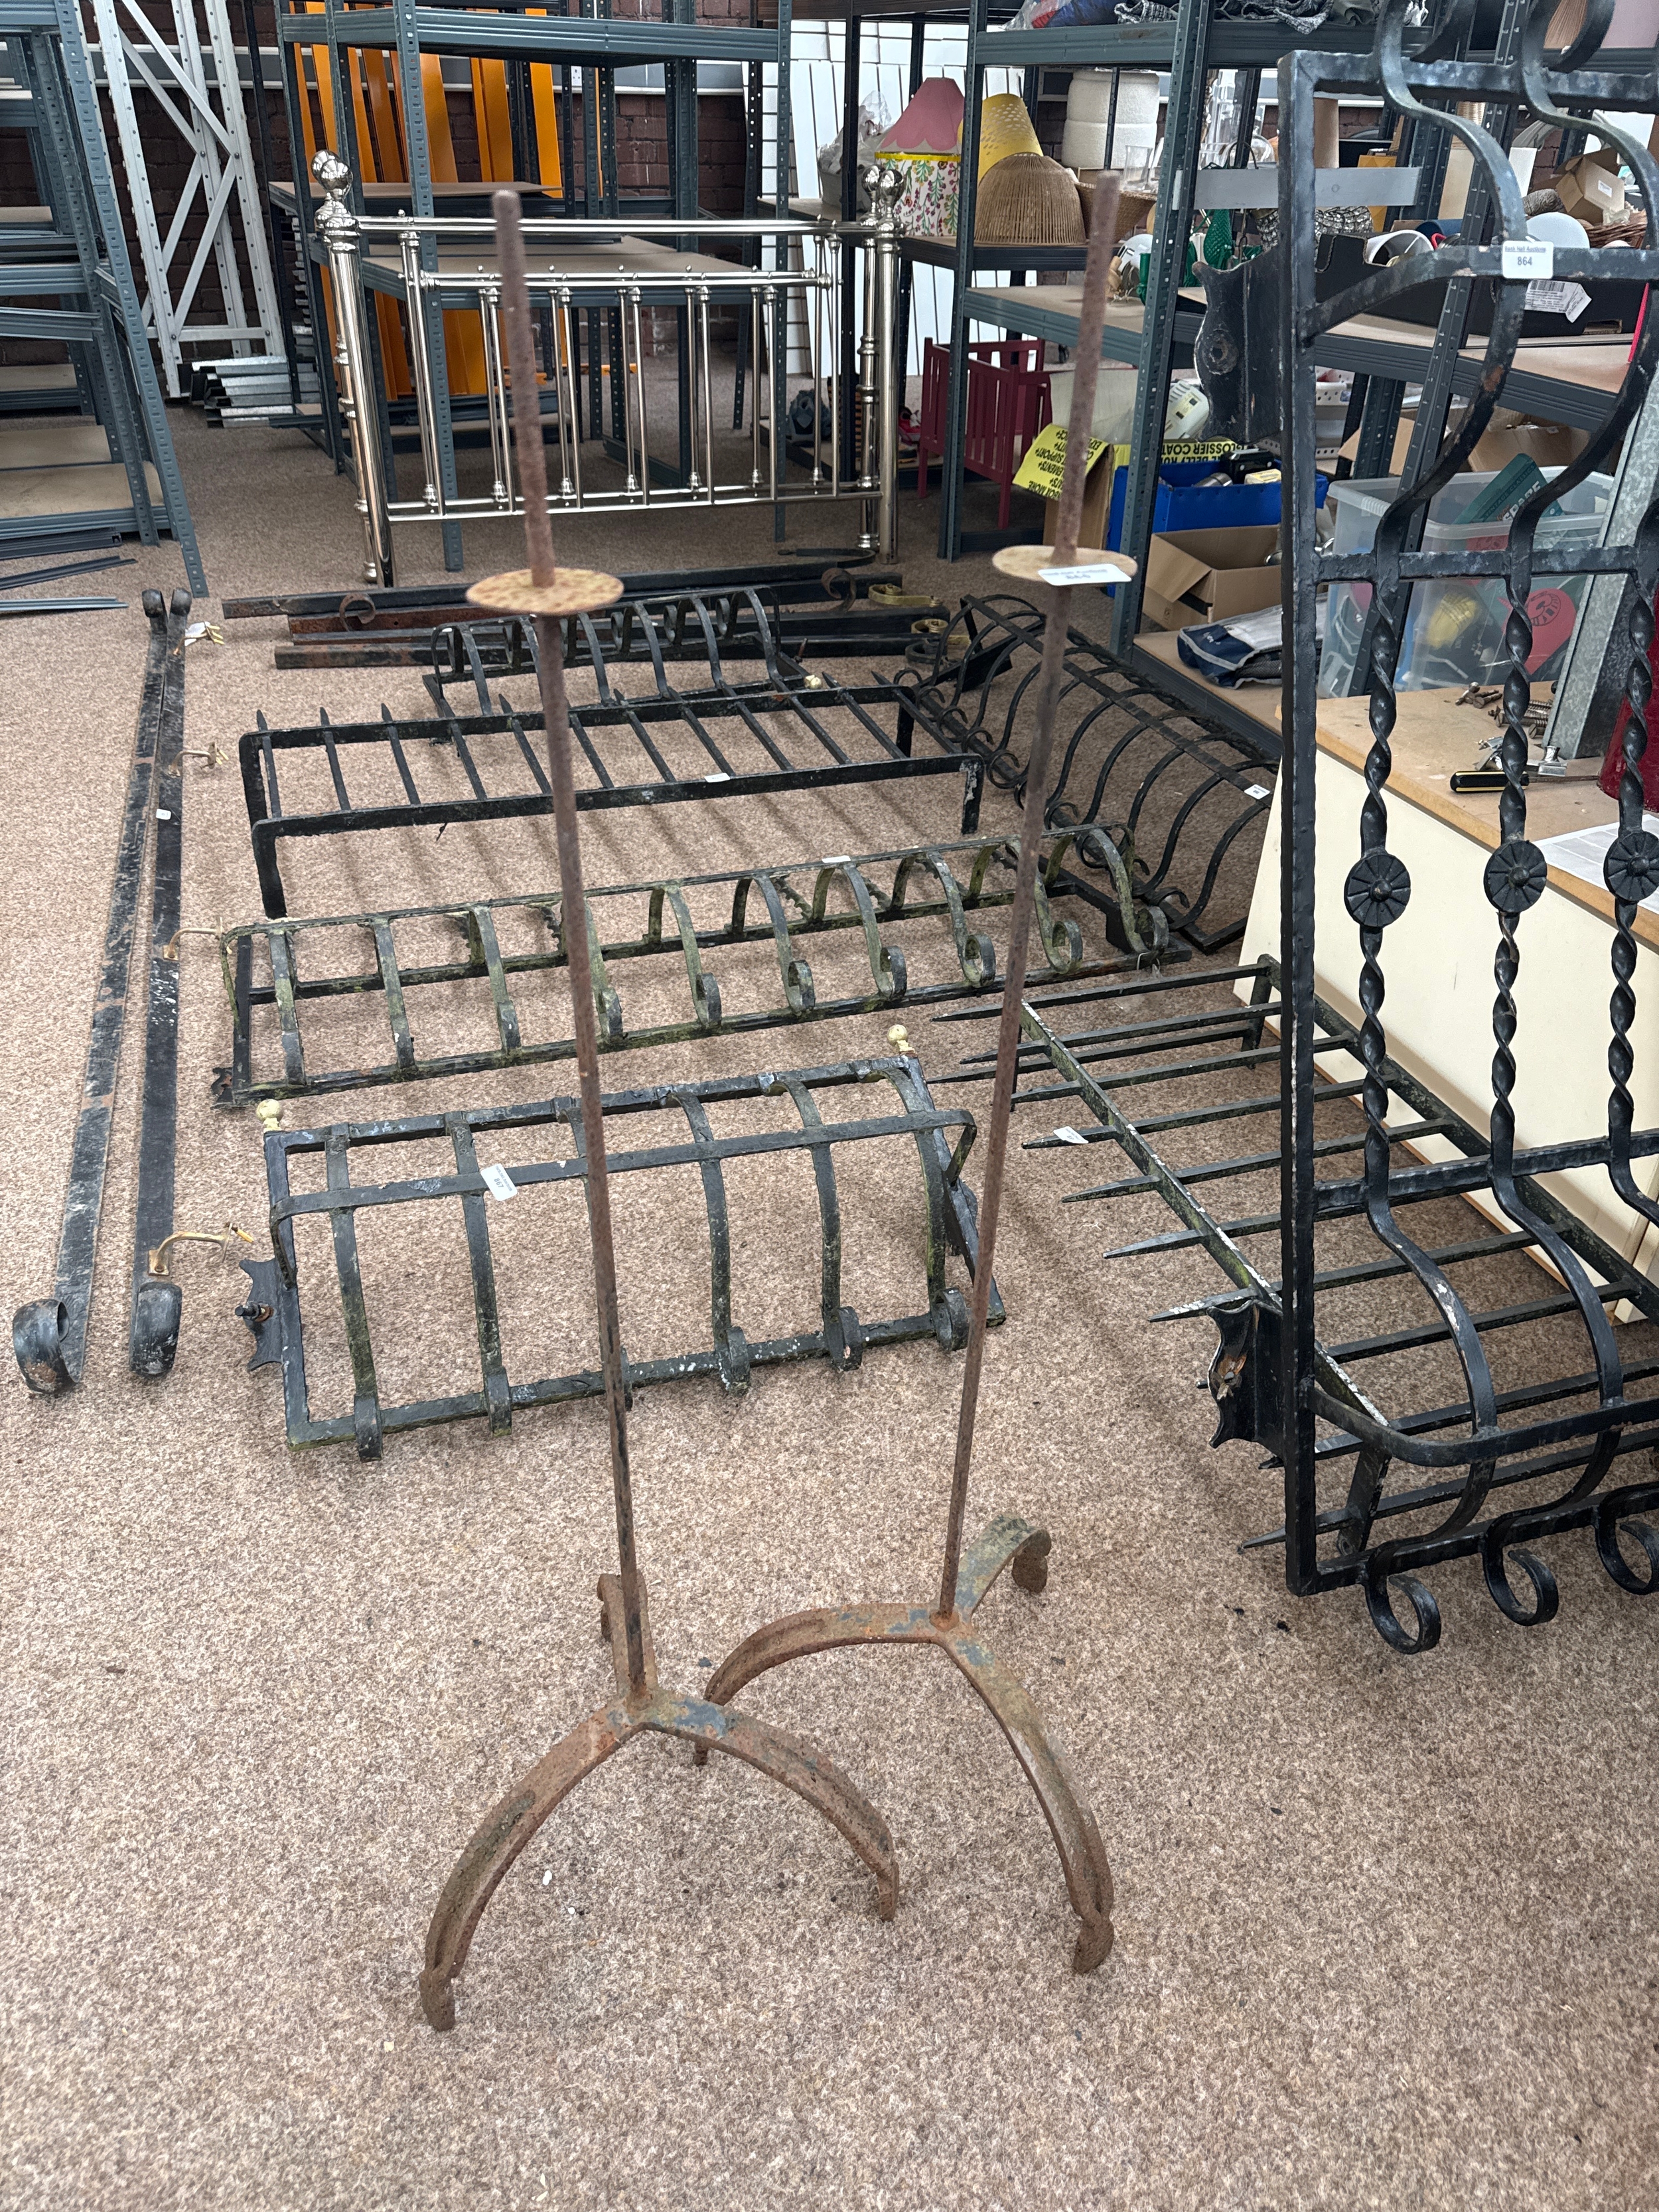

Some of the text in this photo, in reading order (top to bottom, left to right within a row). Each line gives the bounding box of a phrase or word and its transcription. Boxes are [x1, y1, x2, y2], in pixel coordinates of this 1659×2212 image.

[1517, 256, 1533, 265] 864
[1163, 444, 1191, 455] COAT
[494, 1177, 504, 1188] 867
